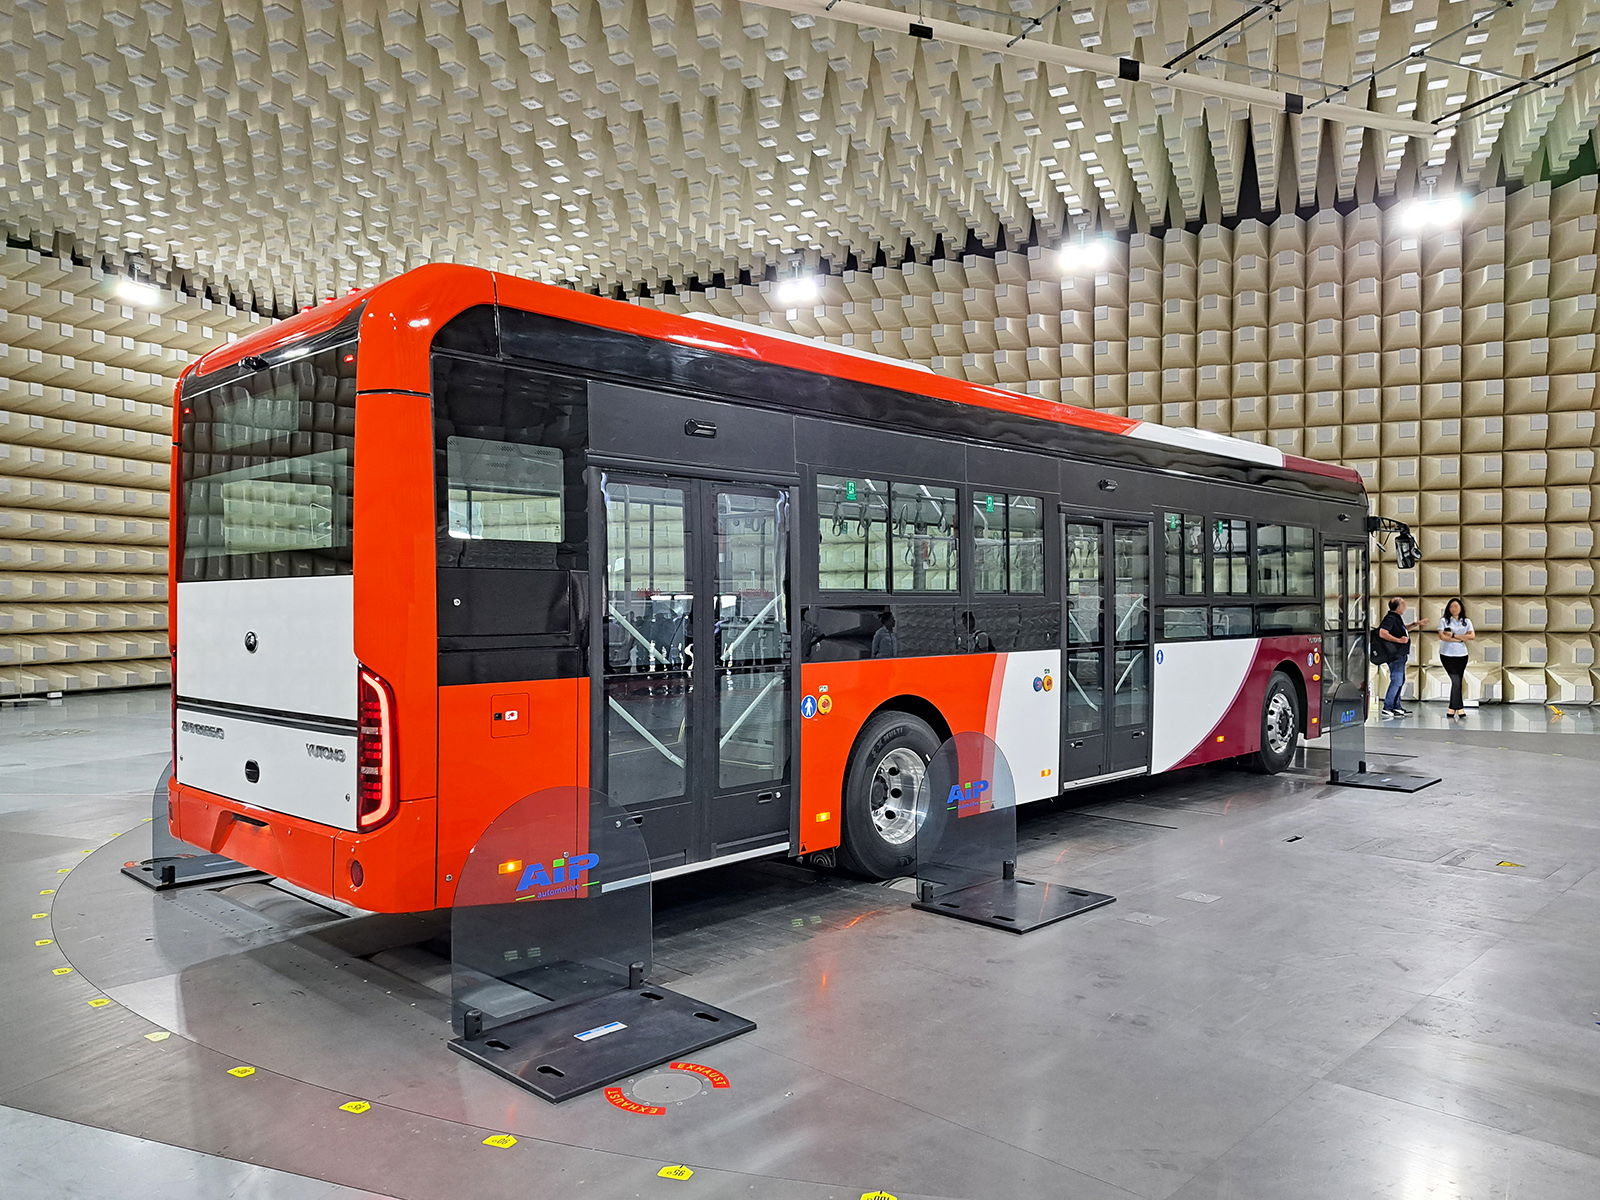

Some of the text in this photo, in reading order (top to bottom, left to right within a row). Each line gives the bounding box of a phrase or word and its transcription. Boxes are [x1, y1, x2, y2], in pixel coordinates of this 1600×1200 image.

[305, 743, 346, 763] YUTONG
[537, 884, 580, 898] automotive
[677, 1063, 727, 1086] EXHAUST
[607, 1090, 658, 1114] EXHAUST
